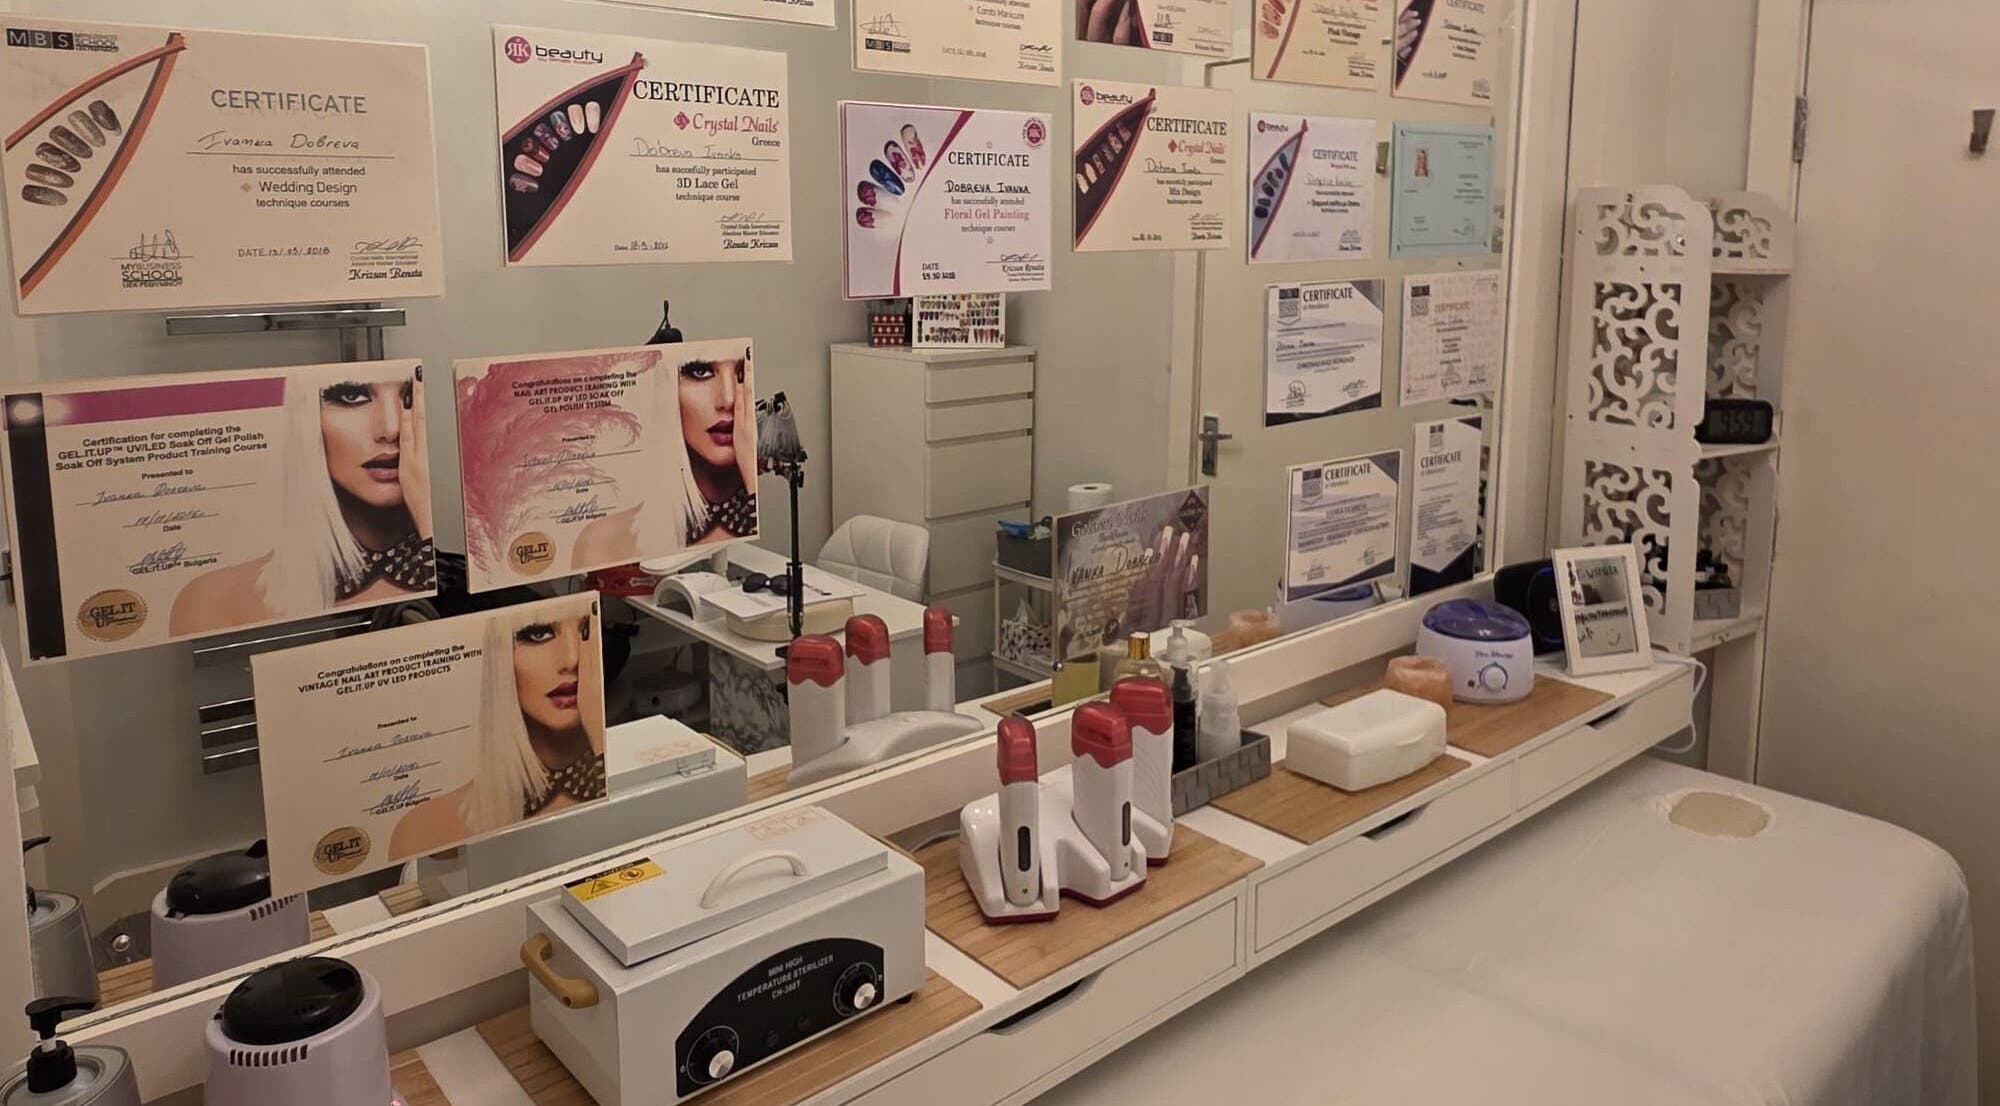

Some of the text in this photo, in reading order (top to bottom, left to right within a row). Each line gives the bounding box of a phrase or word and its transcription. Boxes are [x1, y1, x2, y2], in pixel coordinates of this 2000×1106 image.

[535, 44, 604, 64] beauty
[211, 89, 367, 114] CERTIFICATE
[633, 80, 780, 108] CERTIFICATE
[692, 113, 778, 137] Crystal Nails
[1147, 116, 1227, 136] CERTIFICATE
[751, 136, 781, 147] Greece
[948, 151, 1030, 167] CERTIFICATE
[1312, 148, 1359, 162] CERTIFICATE
[233, 164, 366, 177] has successfully attended
[713, 167, 757, 177] participated
[259, 180, 358, 195] Wedding Design
[676, 177, 739, 190] 3D Lace Gel
[944, 179, 991, 194] DOBREVA
[256, 198, 350, 209] technique courses
[675, 193, 714, 204] technique
[944, 208, 1030, 221] Floral Gel Painting
[121, 270, 182, 281] SCHOOL
[1302, 287, 1353, 302] CERTIFICATE
[549, 384, 583, 394] PRODUCT
[584, 380, 619, 392] TRAINING
[619, 379, 637, 388] WITH
[543, 405, 558, 414] GEL
[559, 402, 585, 412] POLISH
[83, 425, 241, 448] Certification for completing the
[126, 441, 167, 454] UV/LED
[169, 438, 195, 450] Soak
[197, 436, 213, 446] Off
[214, 434, 232, 445] Gel
[234, 432, 264, 443] Polish
[56, 441, 268, 472] Soak Off System Product Training Course
[1420, 451, 1461, 470] CERTIFICATE
[141, 468, 194, 480] Presented to
[1324, 462, 1371, 482] CERTIFICATE
[162, 524, 182, 533] Date
[184, 557, 217, 568] Bulgaria
[317, 660, 388, 680] Congratulations
[403, 647, 451, 662] completing
[452, 644, 465, 652] the
[298, 649, 482, 694] VINTAGE NAIL ART PRODUCT TRAINING WITH
[377, 679, 390, 688] UV
[391, 675, 407, 685] LED
[408, 664, 452, 681] PRODUCTS
[767, 955, 803, 977] MINI HIGH
[737, 954, 835, 1003] TEMPERATURE STERILIZER
